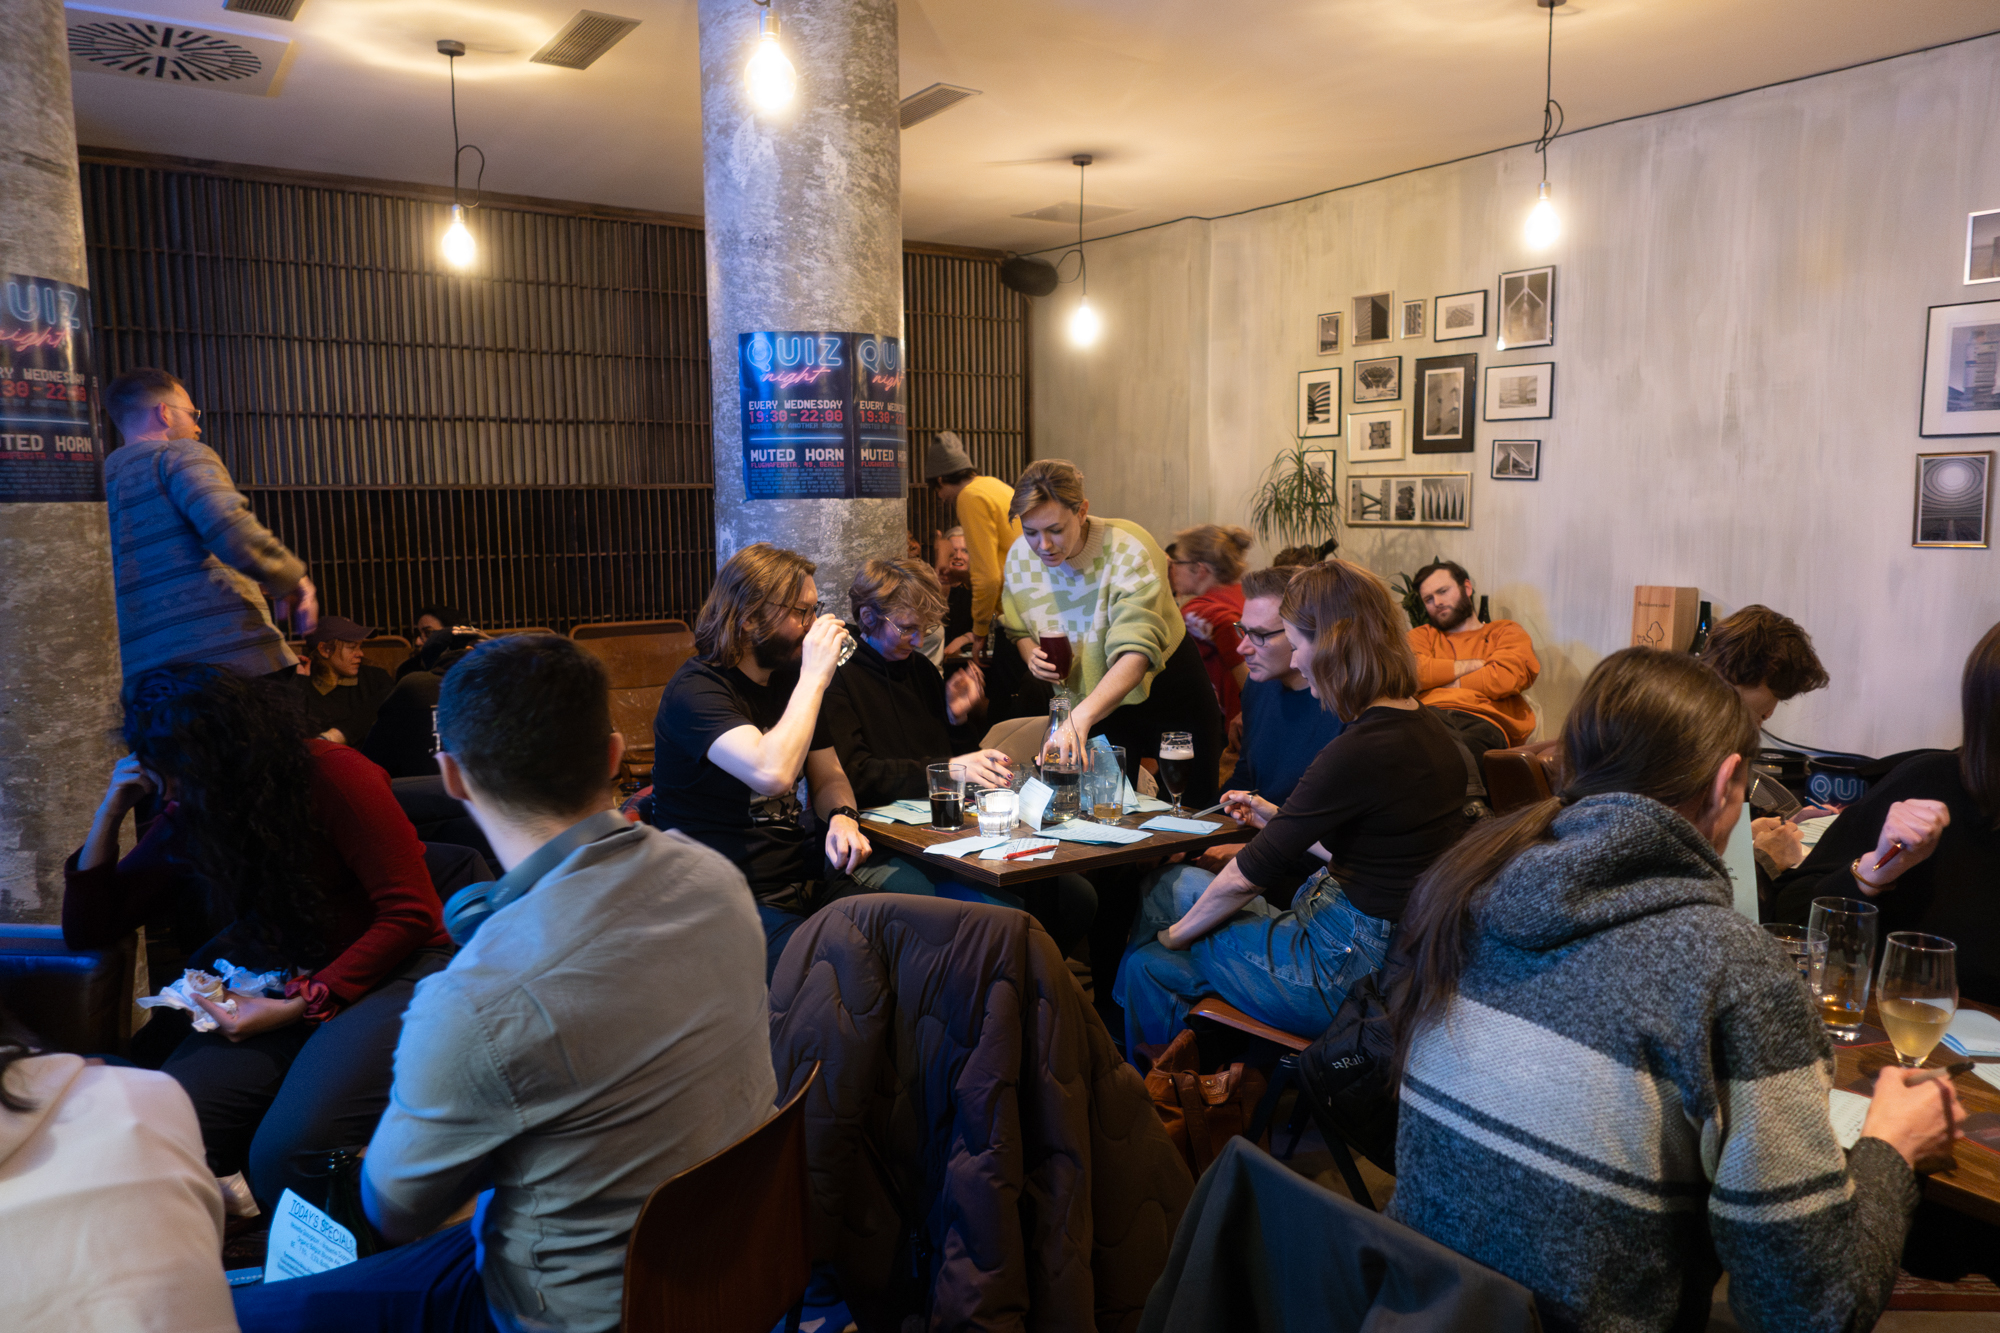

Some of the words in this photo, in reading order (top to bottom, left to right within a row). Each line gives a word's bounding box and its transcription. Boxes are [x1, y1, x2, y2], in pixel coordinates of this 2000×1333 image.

[6, 281, 80, 329] UIZ
[747, 337, 842, 371] QUIZ
[762, 366, 831, 389] night
[749, 400, 778, 410] EVERY
[784, 399, 843, 409] WEDNESDAY
[859, 400, 884, 411] EVERY
[0, 434, 44, 451] TED
[55, 435, 93, 453] HORN
[750, 449, 796, 462] MUTED
[805, 448, 844, 462] HORN
[860, 449, 894, 461] MUTED
[1341, 1054, 1365, 1069] Rab
[290, 1199, 319, 1228] TODAY'S
